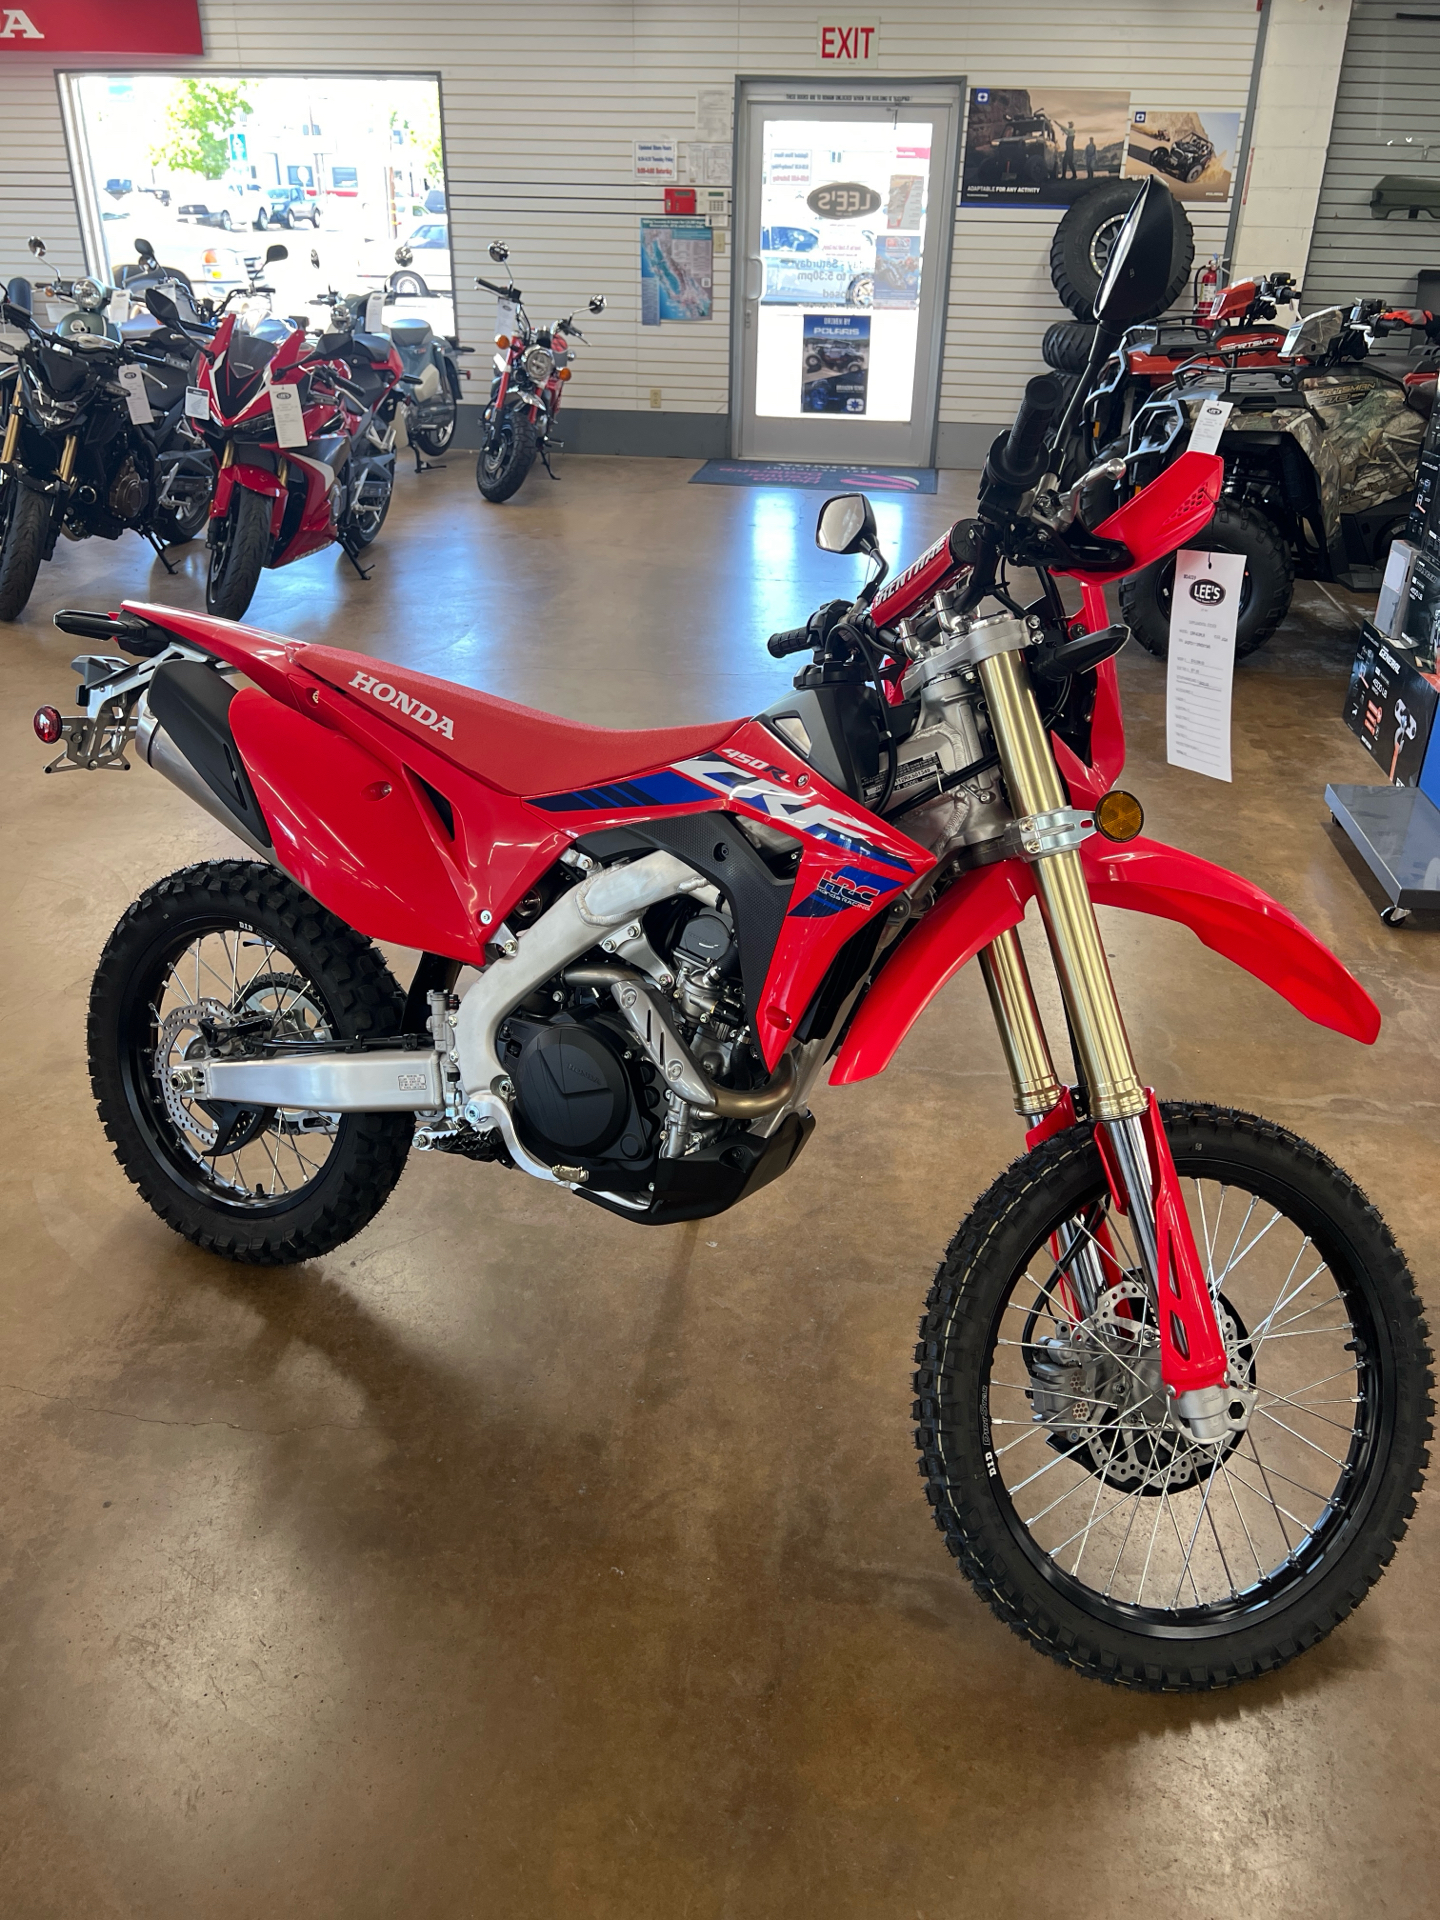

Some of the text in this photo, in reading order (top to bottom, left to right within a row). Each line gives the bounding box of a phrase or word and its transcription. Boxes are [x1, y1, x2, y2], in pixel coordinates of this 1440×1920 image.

[821, 26, 875, 59] EXIT
[814, 327, 860, 336] POLARIS
[1220, 338, 1279, 350] SPORTSMAN
[1194, 584, 1220, 600] LEE'S
[1378, 648, 1401, 675] GENERAL
[348, 670, 454, 740] HONDA
[721, 748, 791, 784] 450RL
[817, 869, 881, 908] HRC
[842, 896, 871, 912] RACING
